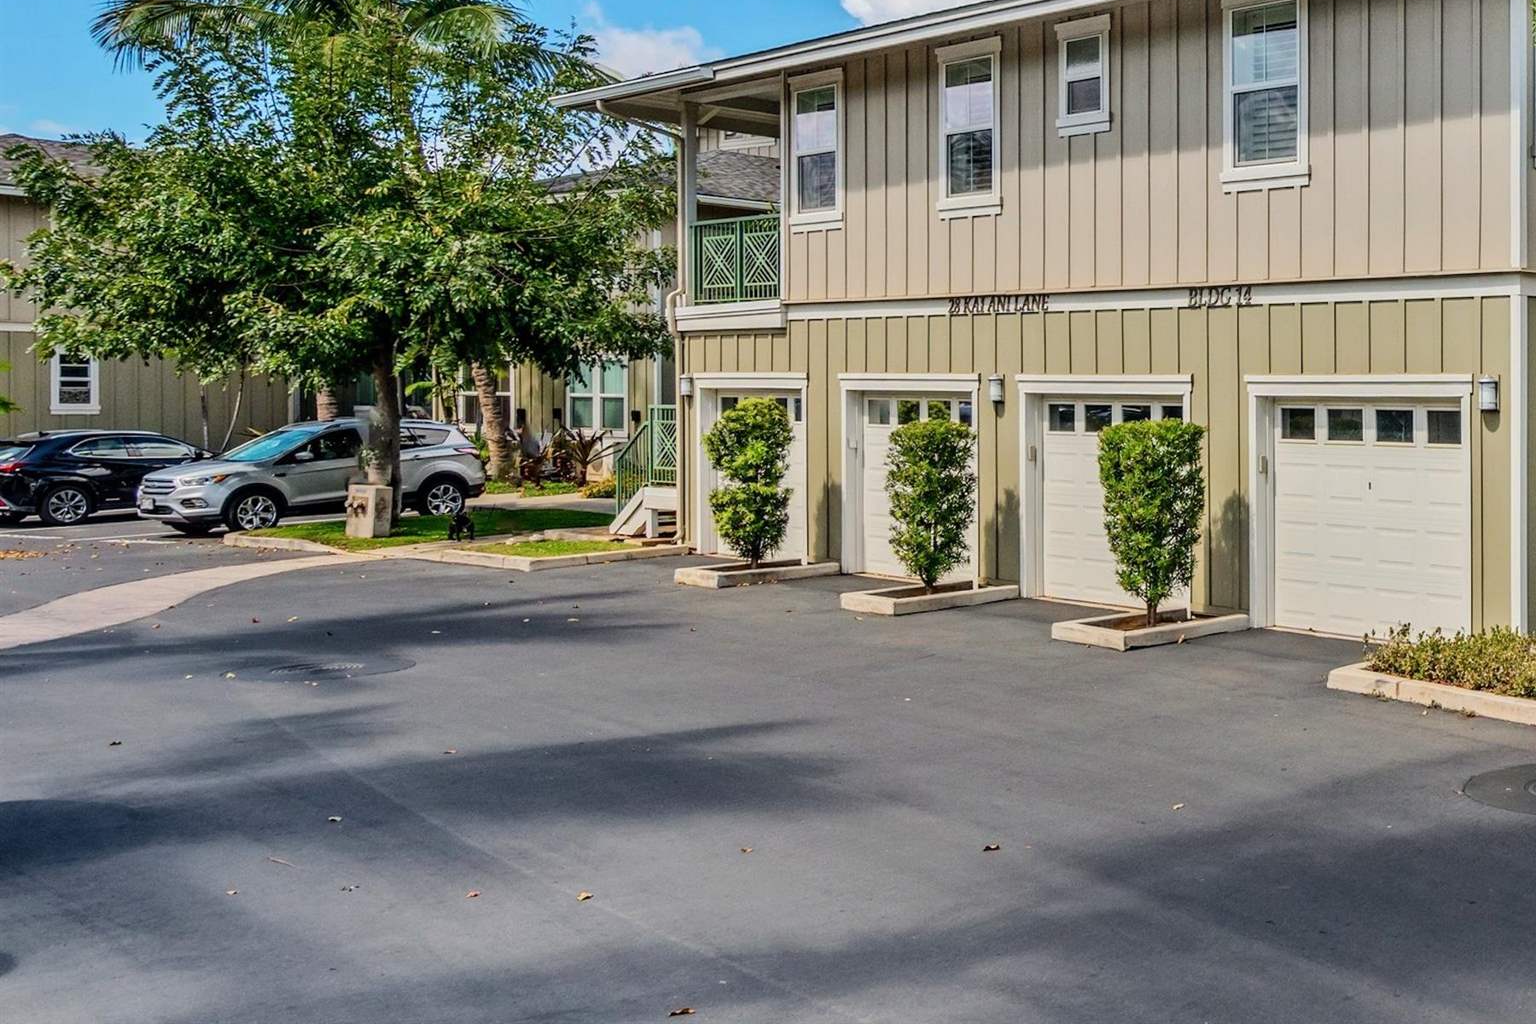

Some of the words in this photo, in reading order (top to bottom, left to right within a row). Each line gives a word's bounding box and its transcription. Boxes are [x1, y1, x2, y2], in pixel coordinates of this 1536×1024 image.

[948, 297, 961, 314] 28
[1014, 295, 1049, 312] LANE
[1188, 286, 1232, 307] BLDG
[1236, 285, 1252, 305] 14
